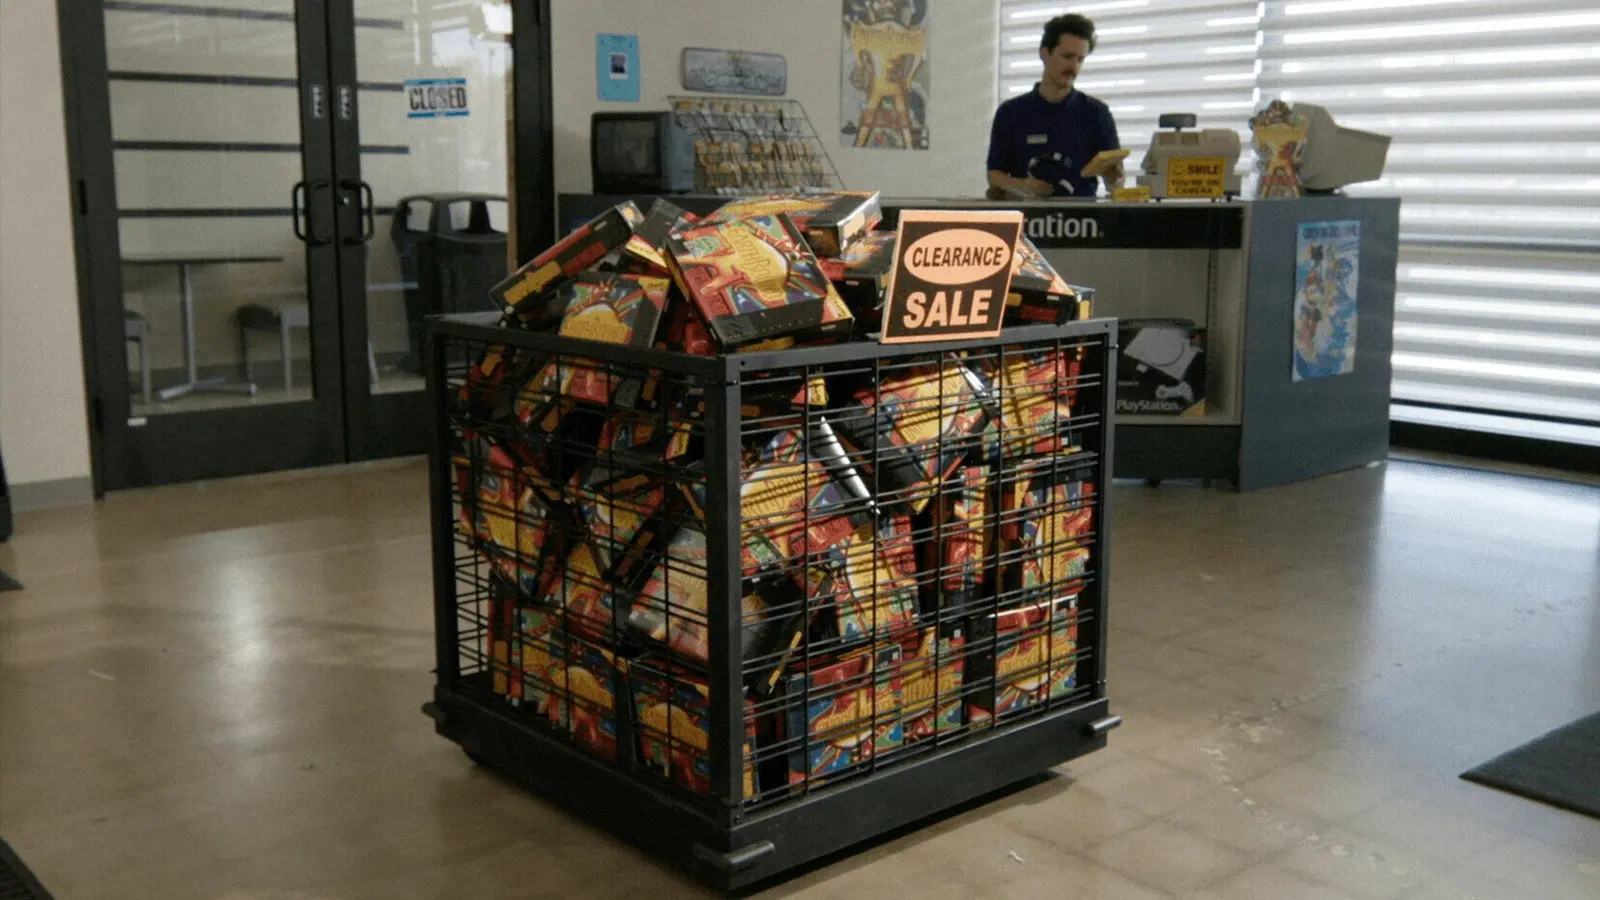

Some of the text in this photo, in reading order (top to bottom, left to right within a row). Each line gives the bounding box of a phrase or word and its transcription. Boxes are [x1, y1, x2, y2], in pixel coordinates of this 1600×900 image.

[409, 86, 467, 110] CLOSED
[1187, 164, 1221, 175] SMILE
[912, 246, 1004, 268] CLEARANCE
[902, 289, 993, 329] SALE
[1116, 399, 1178, 413] PlayStation
